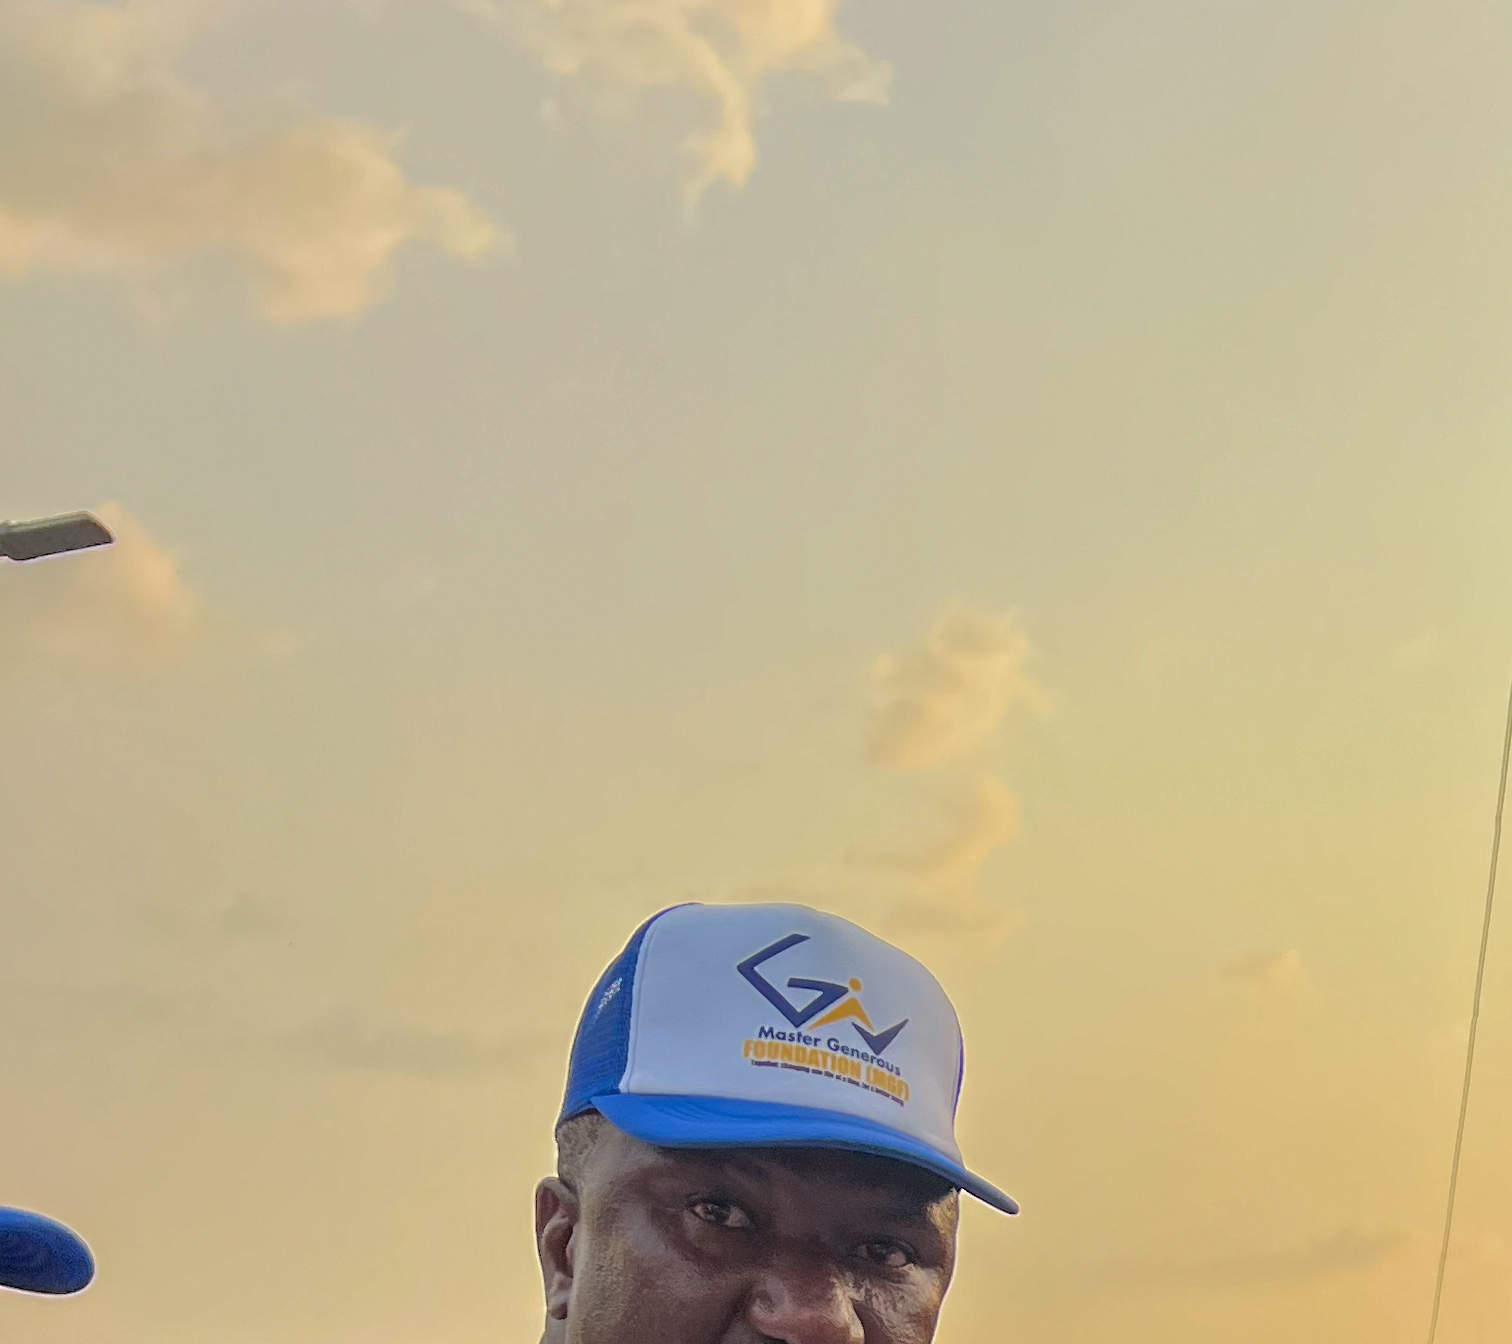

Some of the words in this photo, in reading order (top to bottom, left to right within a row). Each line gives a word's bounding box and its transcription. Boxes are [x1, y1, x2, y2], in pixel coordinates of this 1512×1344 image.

[743, 1040, 862, 1081] FOUNDATION
[758, 1026, 821, 1047] Master
[827, 1037, 901, 1076] Generous
